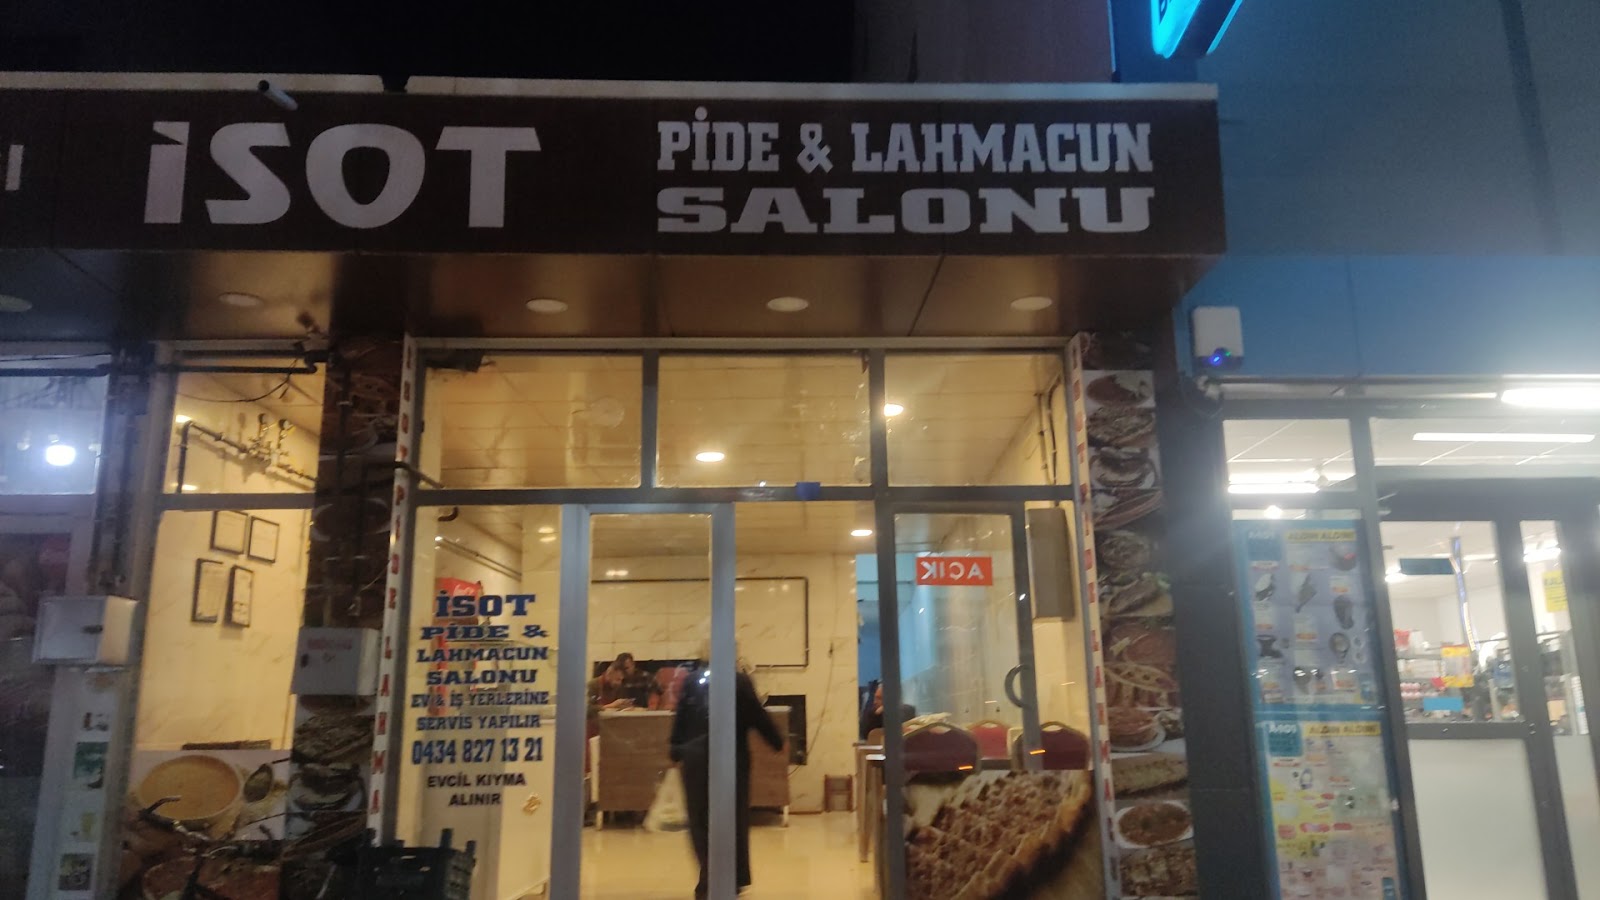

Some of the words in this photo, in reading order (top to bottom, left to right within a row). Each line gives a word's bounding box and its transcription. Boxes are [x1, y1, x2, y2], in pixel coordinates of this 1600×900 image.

[657, 106, 780, 171] PİDE
[796, 123, 834, 174] &
[851, 122, 1154, 173] LAHMACUN
[144, 121, 541, 229] İSOT
[656, 187, 1155, 234] SALONU
[435, 590, 536, 617] İSOT
[420, 623, 509, 640] PİDE
[522, 625, 551, 638] &
[416, 646, 549, 663] LAHMACUN
[426, 668, 538, 686] SALONU
[411, 694, 430, 708] EV
[436, 694, 445, 707] &
[470, 688, 549, 707] YERLERİNE
[479, 714, 541, 729] YAPILIR
[412, 740, 456, 765] 0434
[462, 738, 495, 763] 827
[501, 737, 520, 762] 13
[524, 737, 543, 762] 21
[427, 771, 471, 788] EVCİL
[476, 773, 527, 787] KIYMA
[448, 792, 502, 807] ALINIR
